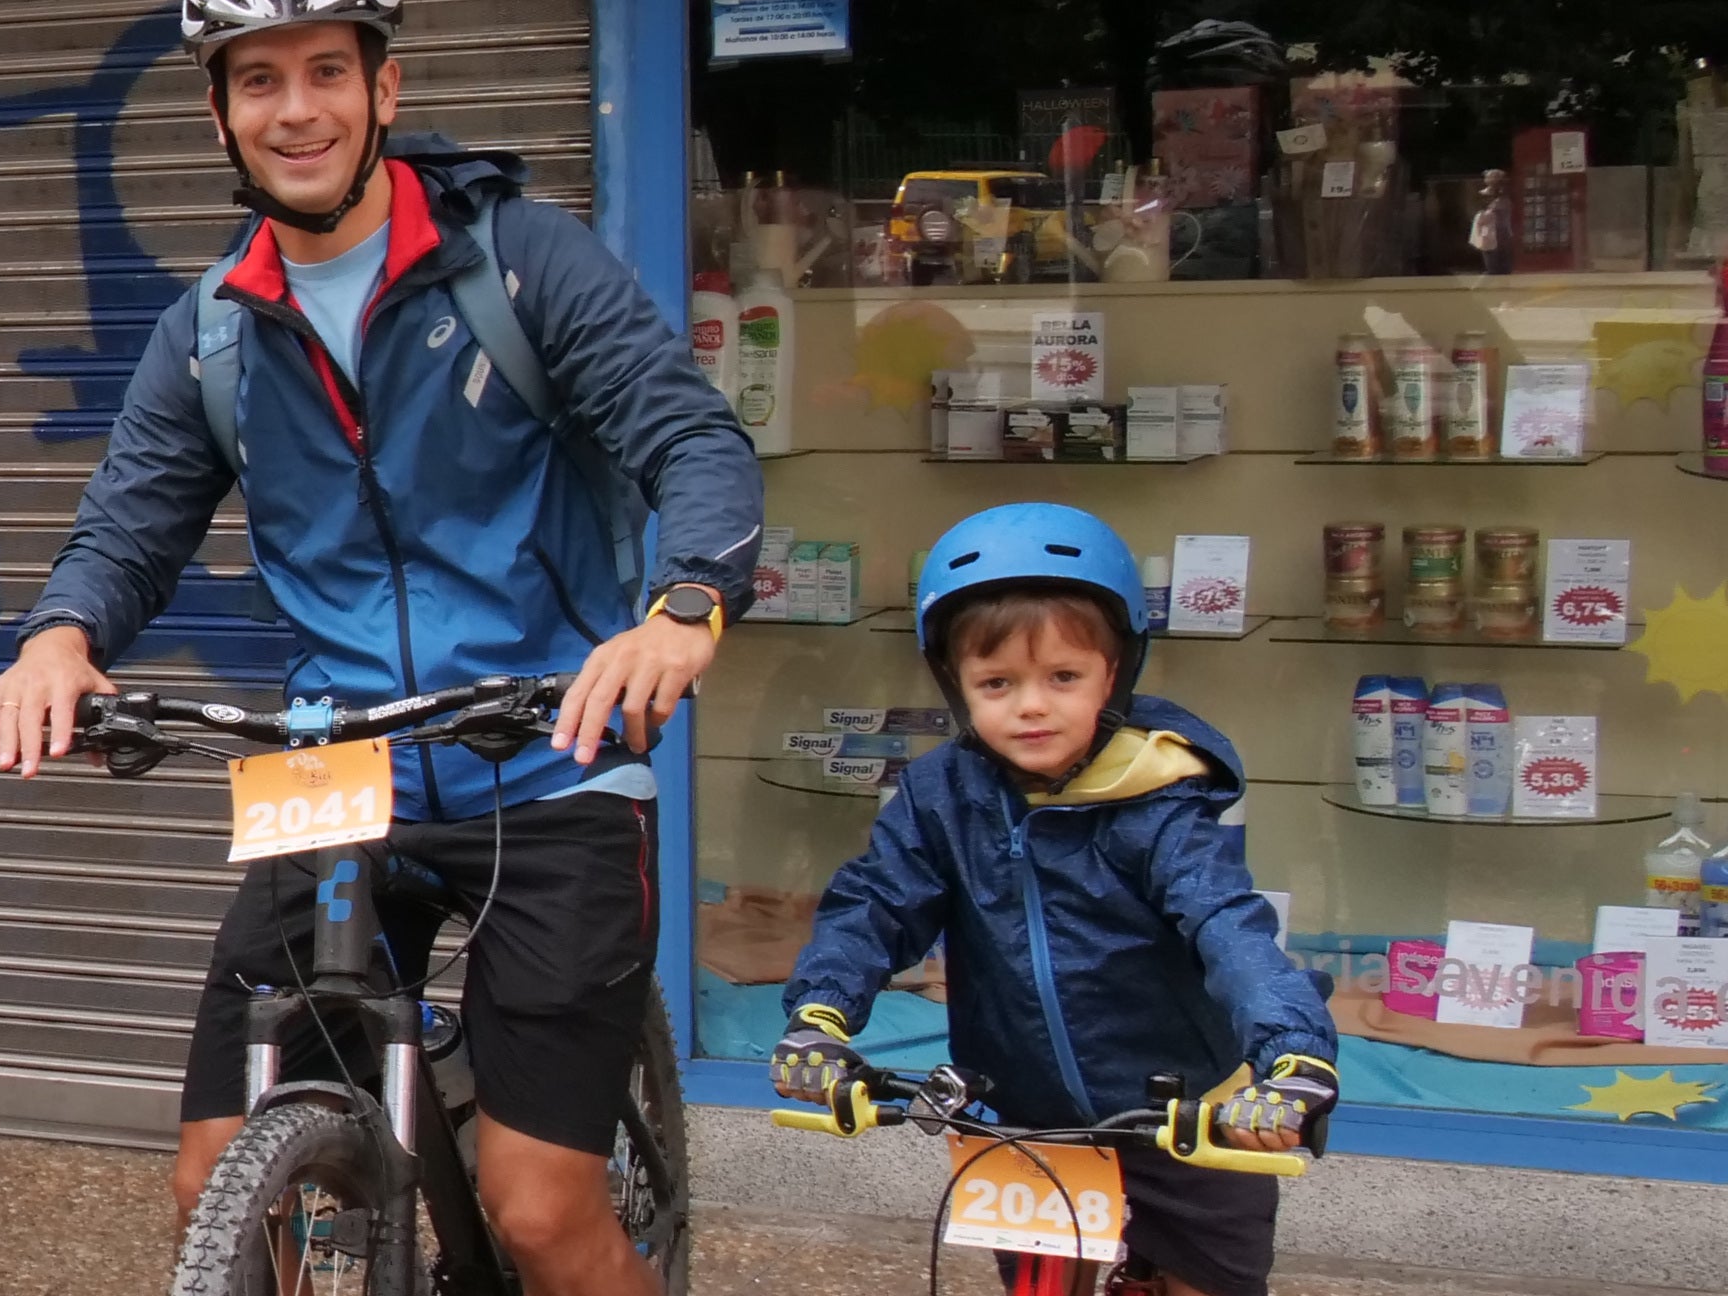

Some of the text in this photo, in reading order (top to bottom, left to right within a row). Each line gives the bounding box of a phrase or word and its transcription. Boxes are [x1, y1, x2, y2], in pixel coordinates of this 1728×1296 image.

[1034, 335, 1099, 346] AURORA
[696, 355, 716, 365] rea
[830, 711, 874, 726] Signal
[789, 735, 833, 750] Signal
[830, 761, 874, 776] Signal
[245, 786, 376, 840] 2041
[961, 1178, 1111, 1233] 2048
